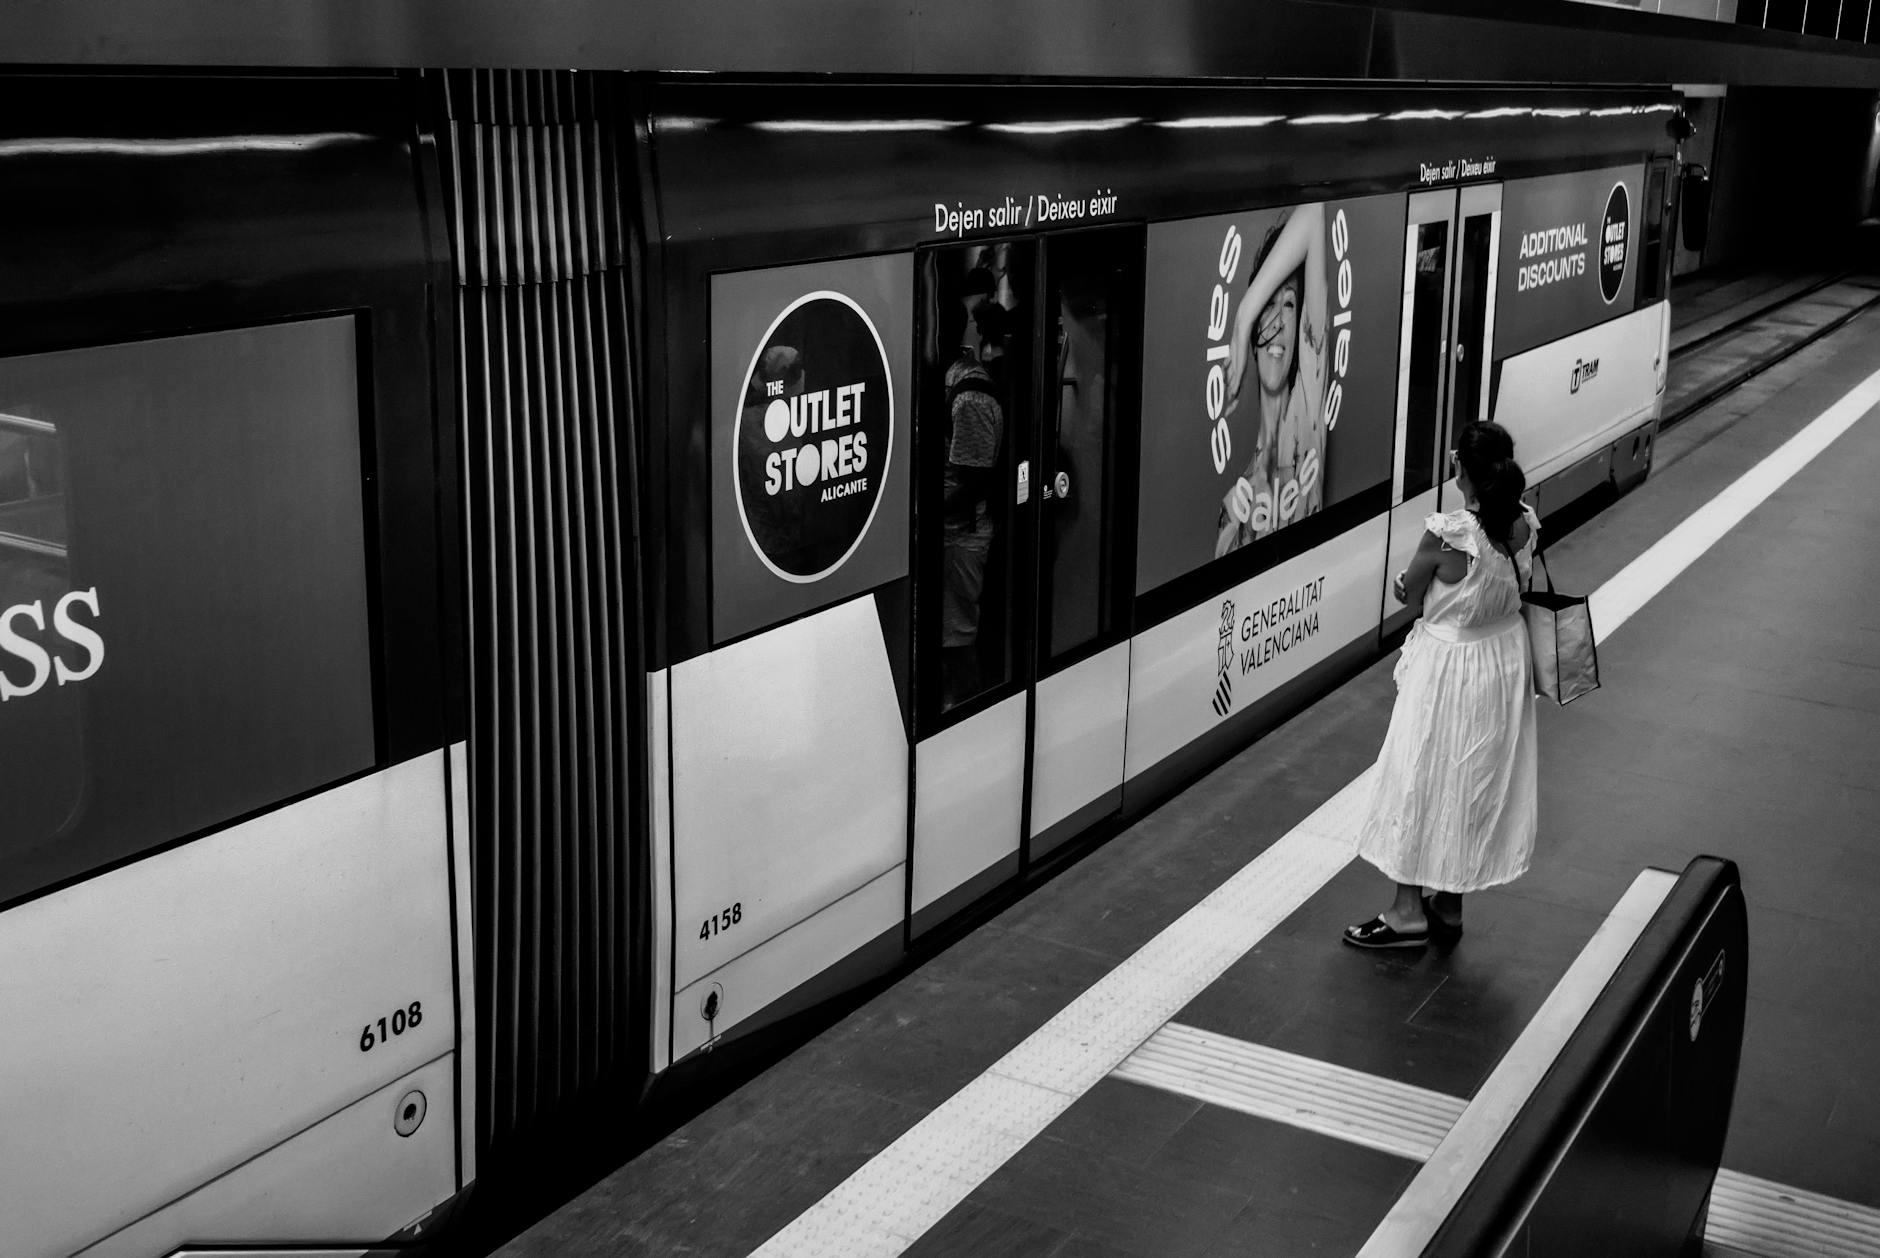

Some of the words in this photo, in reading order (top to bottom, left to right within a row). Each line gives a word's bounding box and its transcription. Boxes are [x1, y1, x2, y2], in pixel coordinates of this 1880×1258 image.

[1420, 162, 1440, 186] Dejen
[1441, 160, 1456, 180] salir
[1461, 158, 1482, 177] Deixeu
[935, 202, 983, 238] Dejen
[988, 197, 1022, 228] salir
[1024, 196, 1033, 227] /
[1038, 193, 1086, 222] Deixeu
[1089, 188, 1118, 216] eixir
[1519, 222, 1588, 260] ADDITIONAL
[1518, 252, 1585, 292] DISCOUNTS
[1323, 208, 1352, 432] sales
[1206, 224, 1242, 475] sales
[764, 381, 866, 443] OUTLET
[766, 379, 784, 397] THE
[764, 430, 868, 496] STORES
[820, 477, 868, 503] ALICANTE
[1232, 447, 1320, 533] sales
[1241, 575, 1325, 642] GENERALITAT
[1240, 611, 1319, 677] VALENCIANA
[699, 902, 742, 941] 4158
[360, 1000, 423, 1052] 6108
